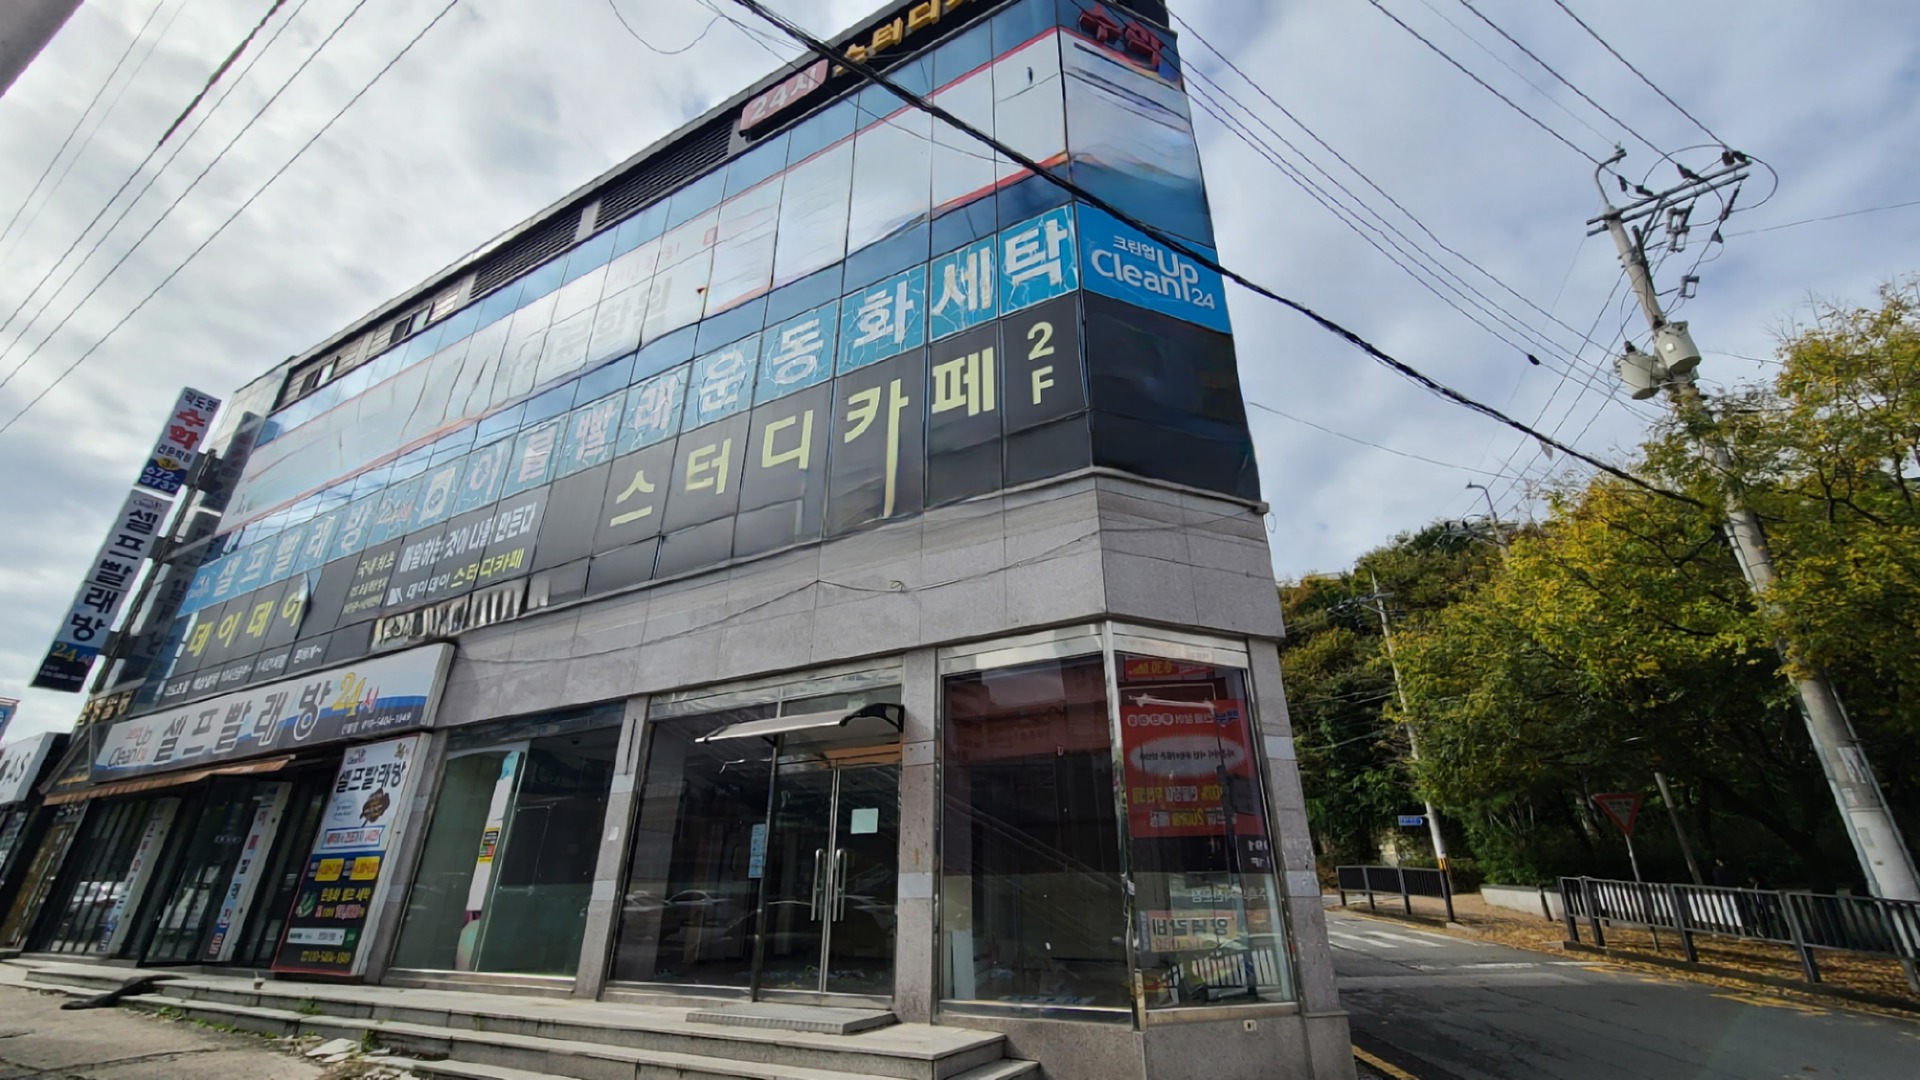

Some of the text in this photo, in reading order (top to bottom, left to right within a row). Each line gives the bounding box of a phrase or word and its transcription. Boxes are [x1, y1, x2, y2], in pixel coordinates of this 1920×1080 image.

[1079, 5, 1163, 71] 수학
[750, 67, 817, 120] 24시
[1113, 235, 1156, 262] 크린업
[1091, 248, 1215, 310] Clean Up 24
[169, 408, 206, 451] 수학
[609, 346, 995, 528] 스터디카페
[141, 475, 179, 491] 3737
[443, 524, 472, 560] 것이
[469, 515, 497, 550] 나를
[494, 502, 538, 543] 만든다
[70, 509, 159, 642] 셀프빨래방
[406, 573, 450, 600] 데이데이
[451, 548, 525, 588] 스터디카페
[152, 671, 380, 766] 셀프빨래방 24시
[336, 761, 406, 793] 셀프빨래방
